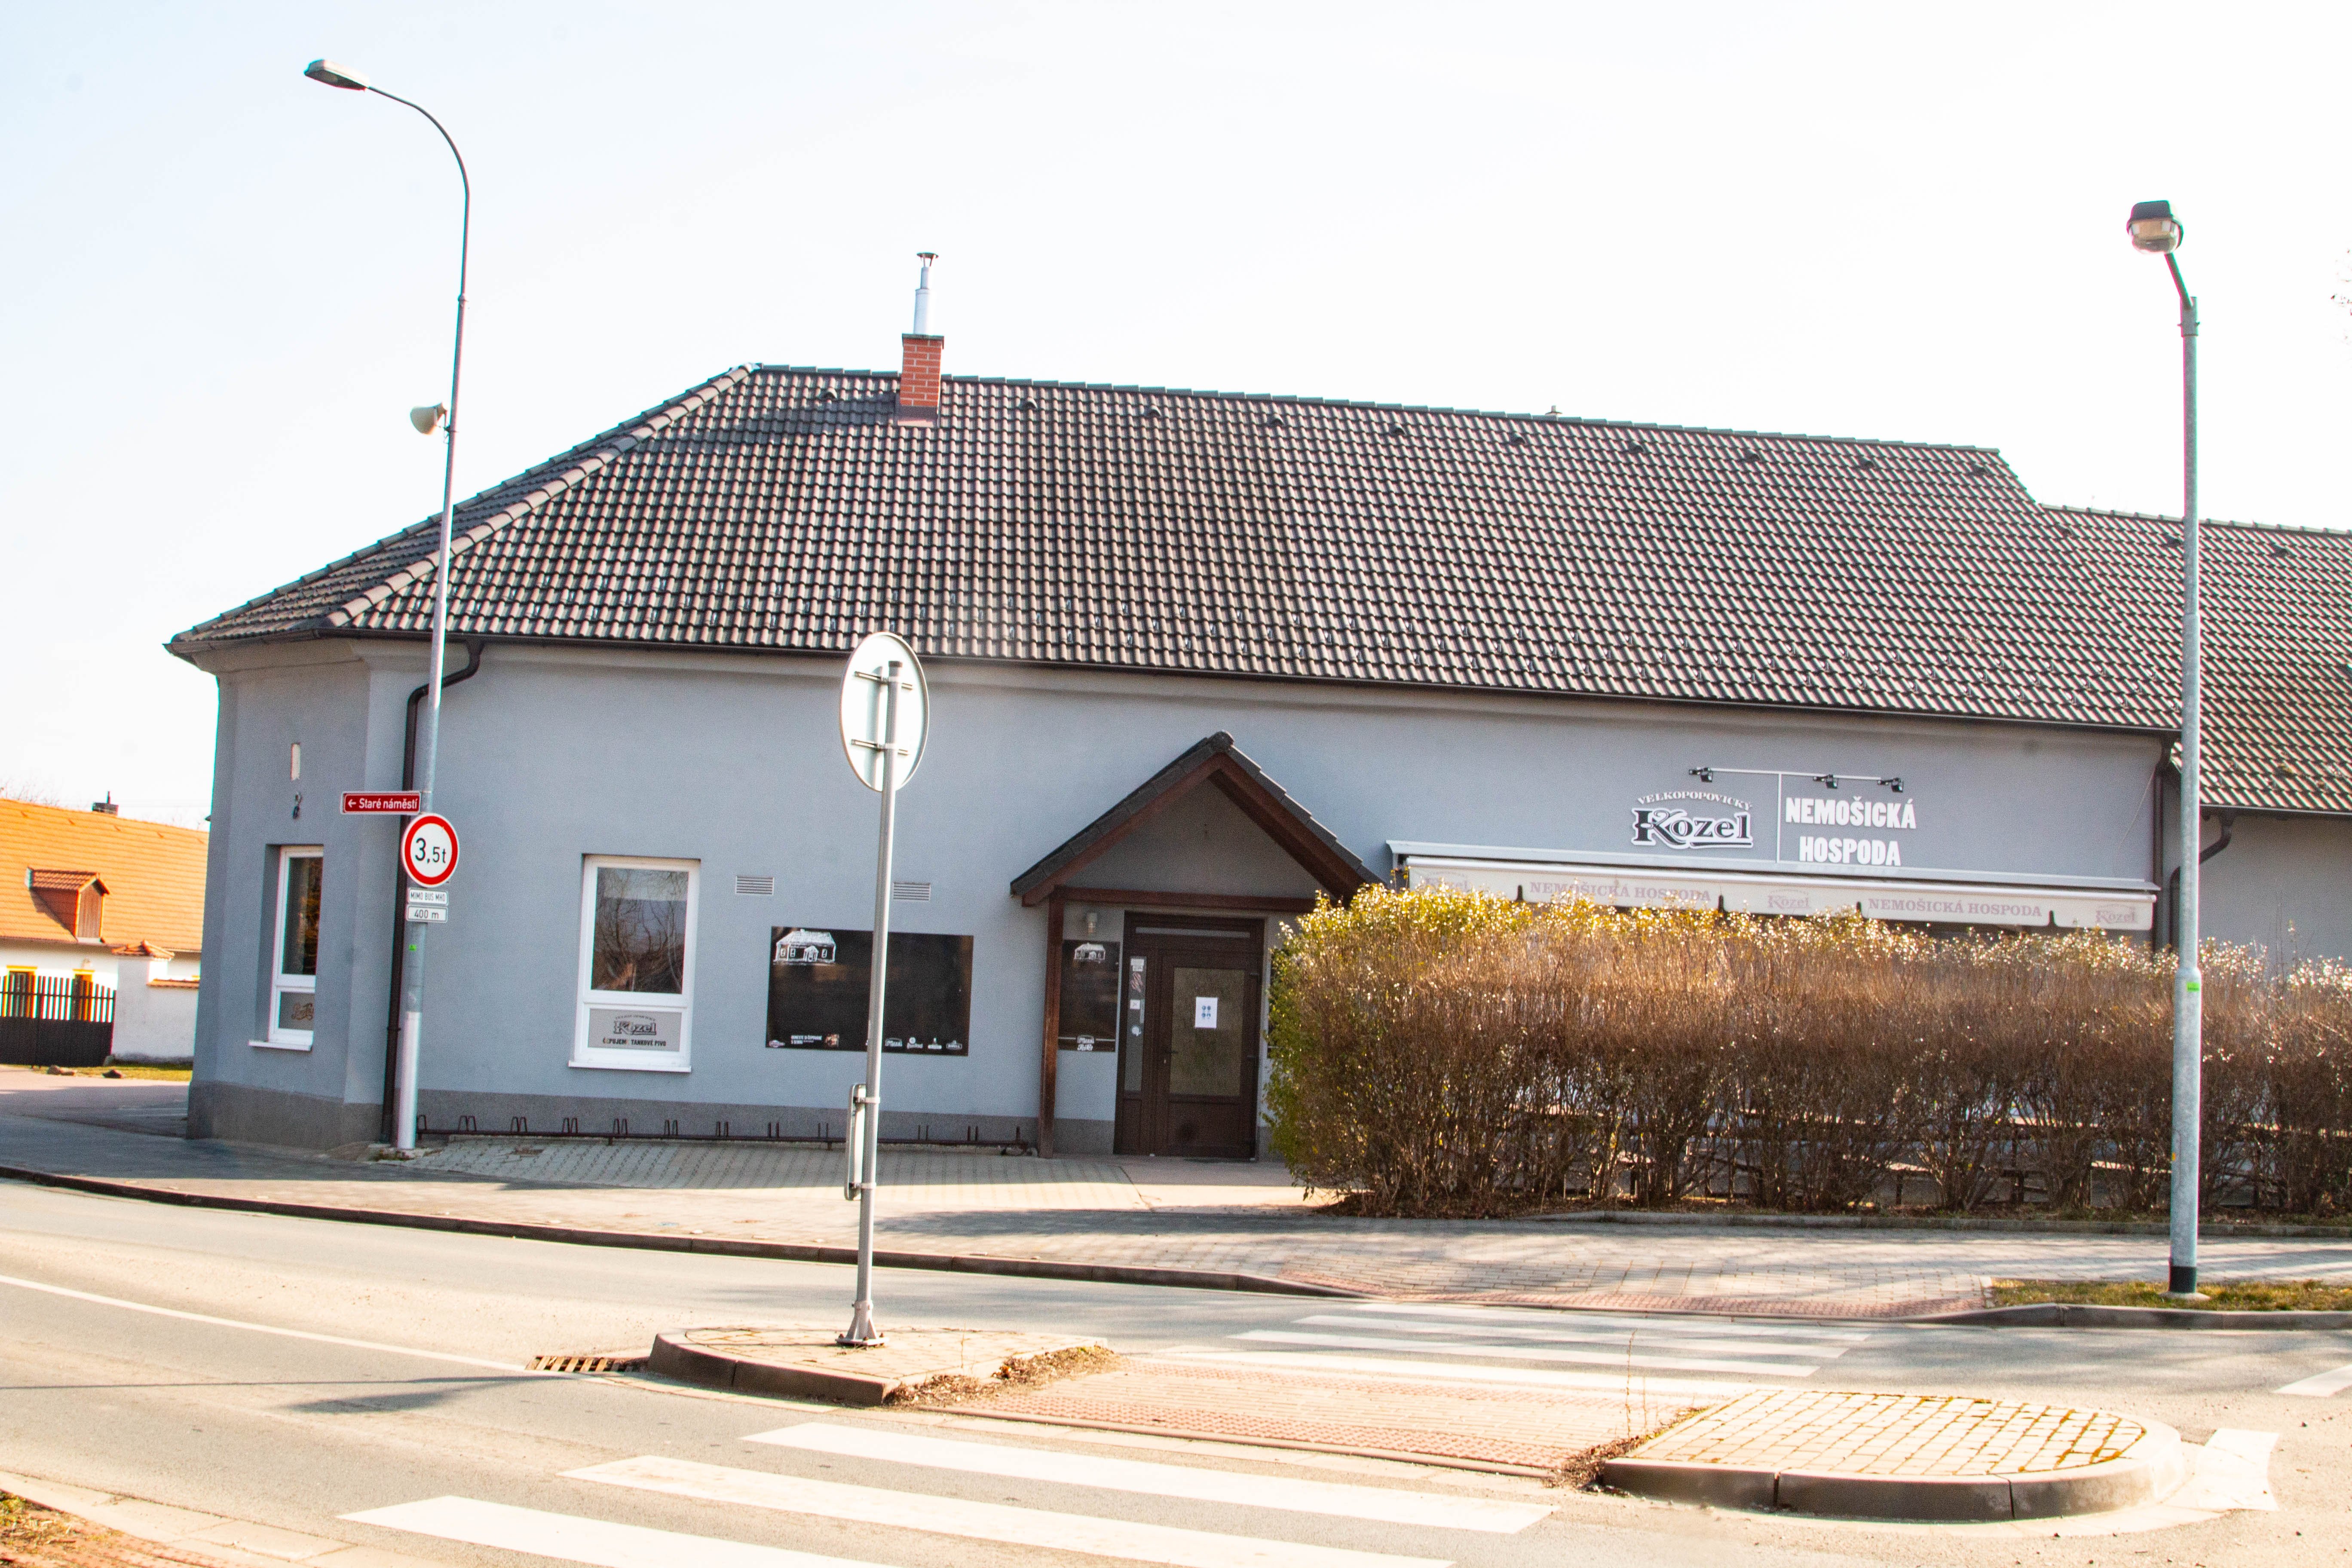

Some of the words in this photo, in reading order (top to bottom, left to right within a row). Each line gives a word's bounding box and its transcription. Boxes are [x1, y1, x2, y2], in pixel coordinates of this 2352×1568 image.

[359, 798, 381, 809] Staré
[383, 798, 418, 809] náměstí
[1785, 796, 1916, 829] NEMOŠICKÁ
[1632, 808, 1753, 848] Kozel
[1799, 836, 1901, 866] HOSPODA
[411, 892, 423, 900] MIMO
[425, 893, 434, 901] BUS
[436, 894, 445, 902] MHD
[1530, 881, 1630, 897] NEMOŠICKÁ
[1634, 887, 1711, 901] HOSPODA
[414, 909, 429, 919] 400
[1868, 898, 1963, 914] NEMOŠICKÁ
[1968, 903, 2043, 917] HOSPODA
